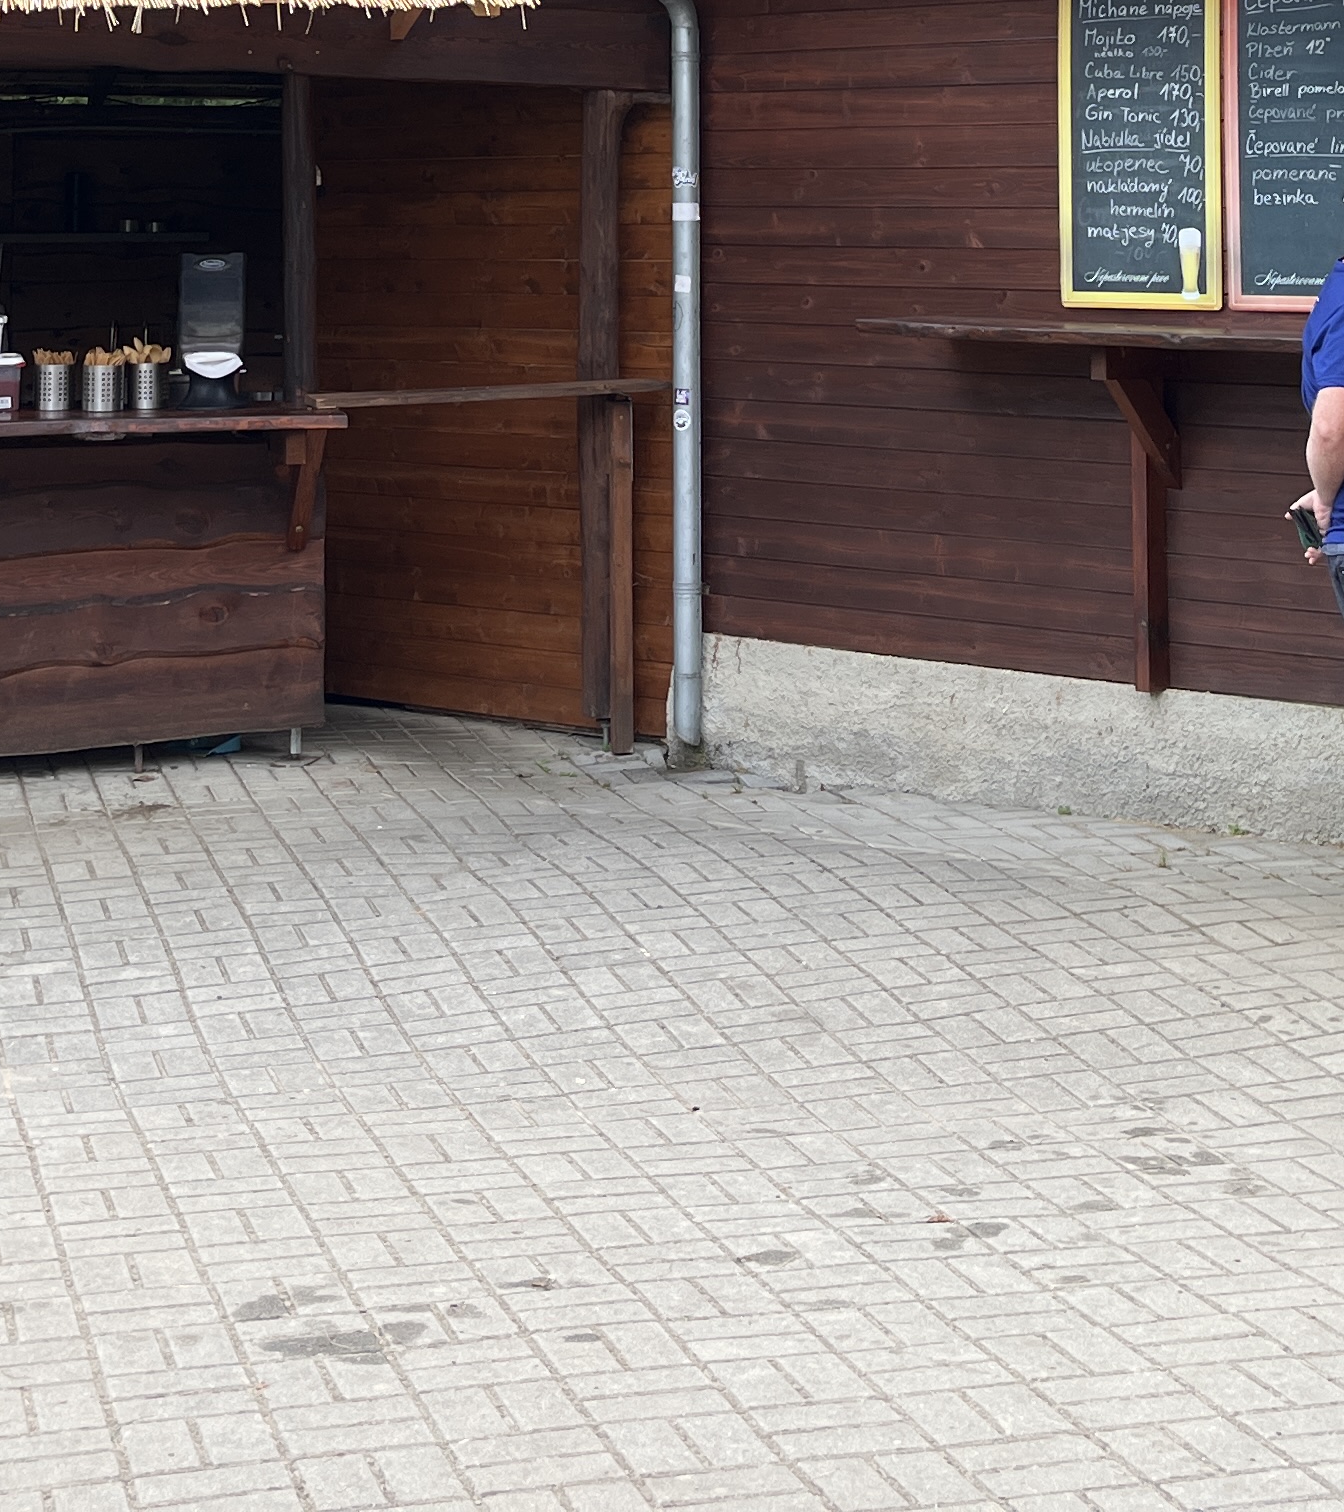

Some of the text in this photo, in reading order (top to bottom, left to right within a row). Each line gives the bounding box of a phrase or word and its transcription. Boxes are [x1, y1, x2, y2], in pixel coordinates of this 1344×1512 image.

[1246, 20, 1341, 37] Klostermann
[1084, 27, 1136, 50] Mojito
[1246, 41, 1295, 58] Plzeň
[1084, 62, 1125, 79] Cuba
[1248, 62, 1298, 80] Cider
[1087, 82, 1139, 102] Aperol
[1248, 82, 1290, 99] Birell
[1085, 104, 1112, 121] Gin
[1120, 107, 1162, 123] Tonic
[1081, 127, 1191, 149] Nabídka jídel
[1244, 130, 1318, 156] Čepované
[1086, 157, 1170, 176] utopenec
[1252, 164, 1342, 186] pomeranč
[1254, 189, 1318, 206] bezinka
[1110, 199, 1175, 218] hermelín
